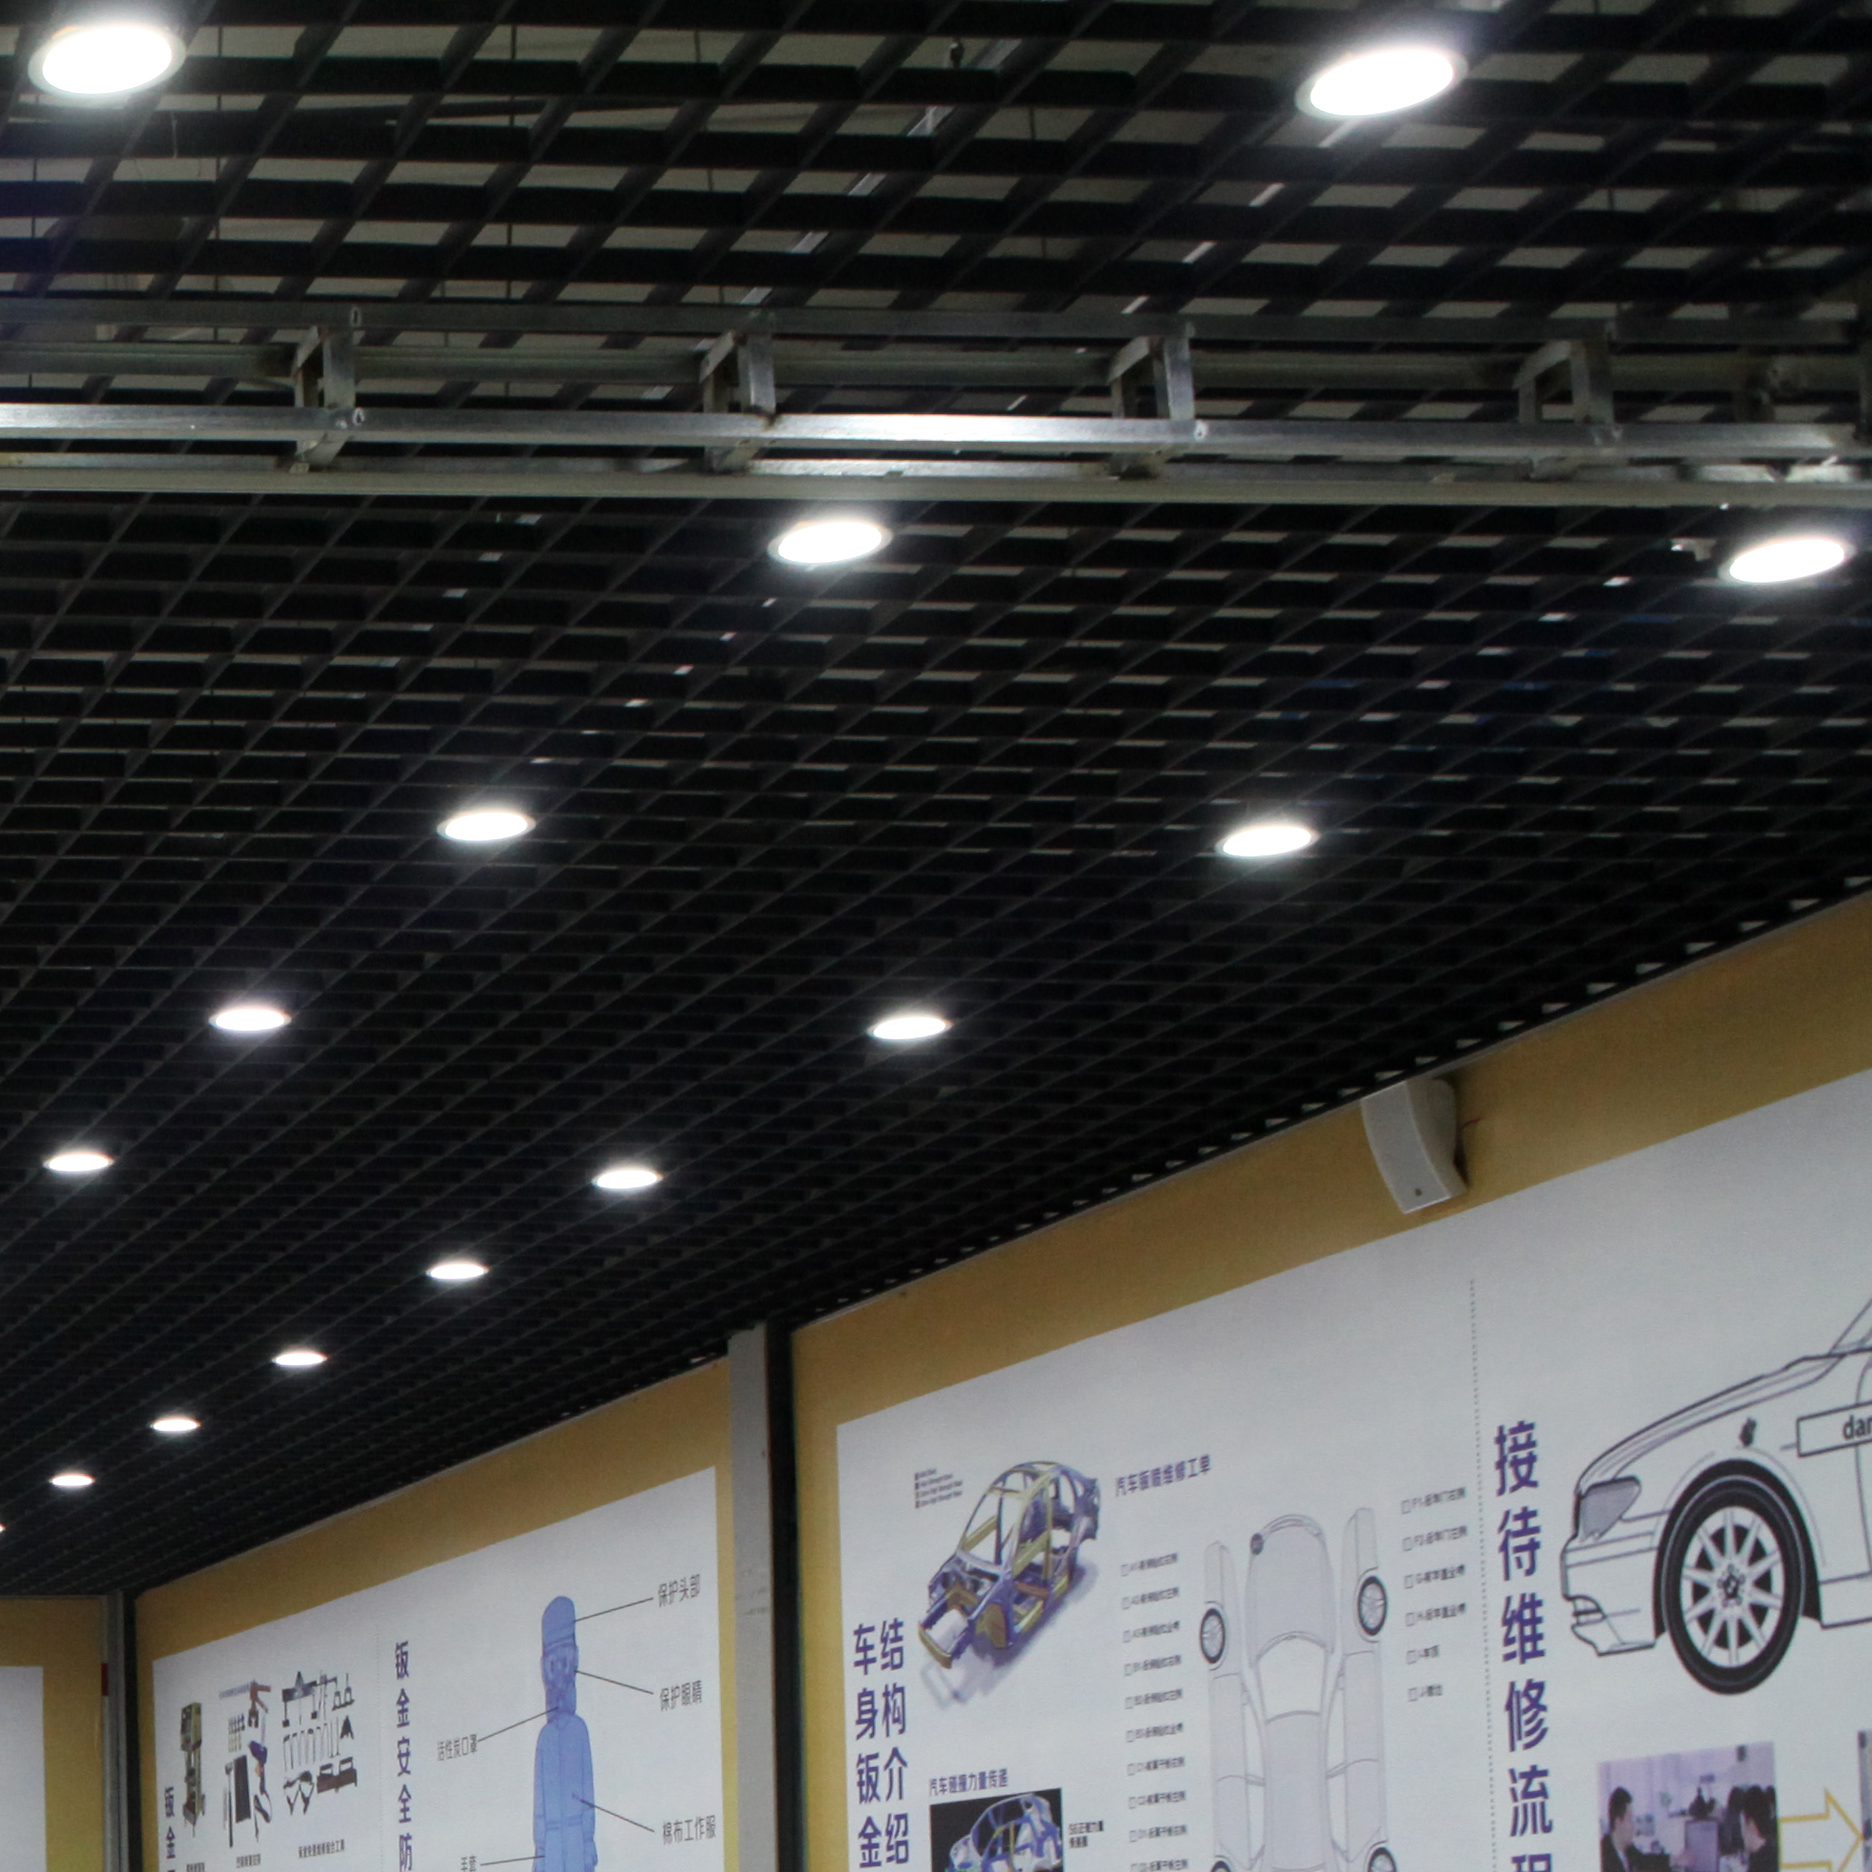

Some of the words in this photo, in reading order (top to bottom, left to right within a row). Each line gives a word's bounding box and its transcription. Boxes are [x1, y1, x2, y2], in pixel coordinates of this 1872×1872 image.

[658, 1574, 700, 1607] 保护头部
[660, 1680, 702, 1711] 保护眼睛
[853, 1622, 882, 1868] 车身钣金
[880, 1617, 909, 1865] 结构介绍
[663, 1815, 716, 1844] 棉布工作服
